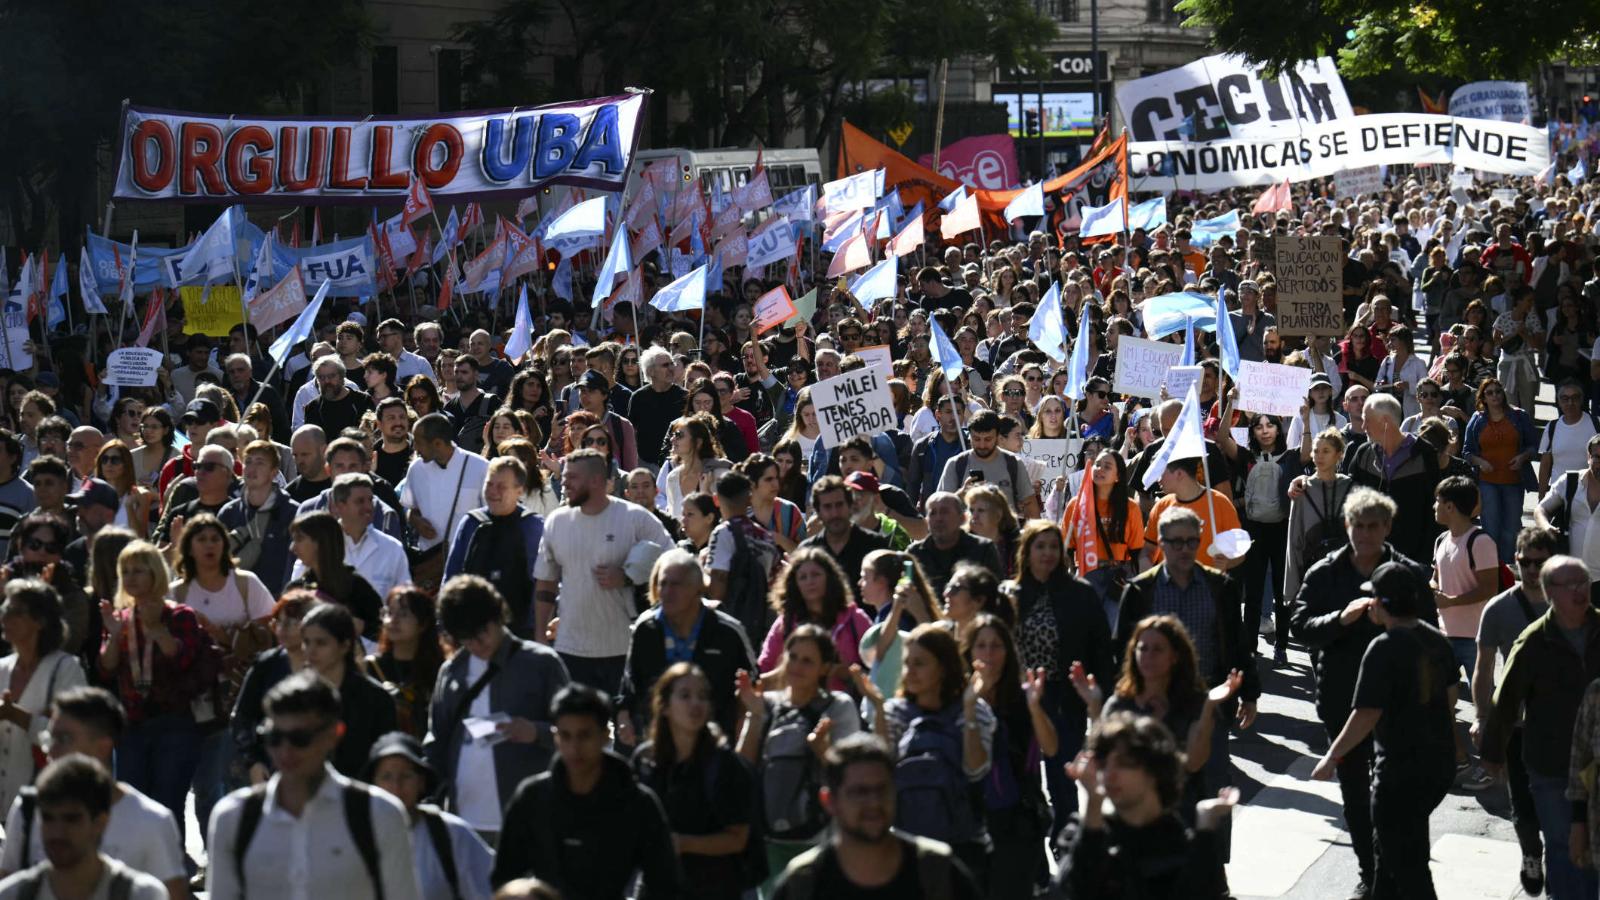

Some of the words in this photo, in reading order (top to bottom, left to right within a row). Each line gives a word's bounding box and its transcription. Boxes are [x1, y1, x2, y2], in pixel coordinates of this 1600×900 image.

[1131, 62, 1337, 142] CECIM
[130, 118, 465, 196] ORGULLO
[480, 104, 626, 184] UBA
[1319, 130, 1349, 158] SE
[1360, 122, 1528, 162] DEFIENDE
[1277, 250, 1339, 265] EDUCACION
[1297, 238, 1321, 251] SIN
[307, 254, 366, 280] FUA
[1280, 263, 1321, 277] VAMOS
[1325, 265, 1335, 275] A
[1281, 314, 1341, 330] PLANISTAS
[1124, 371, 1161, 389] SALU
[818, 397, 866, 425] TENES
[833, 406, 892, 442] PAPADA
